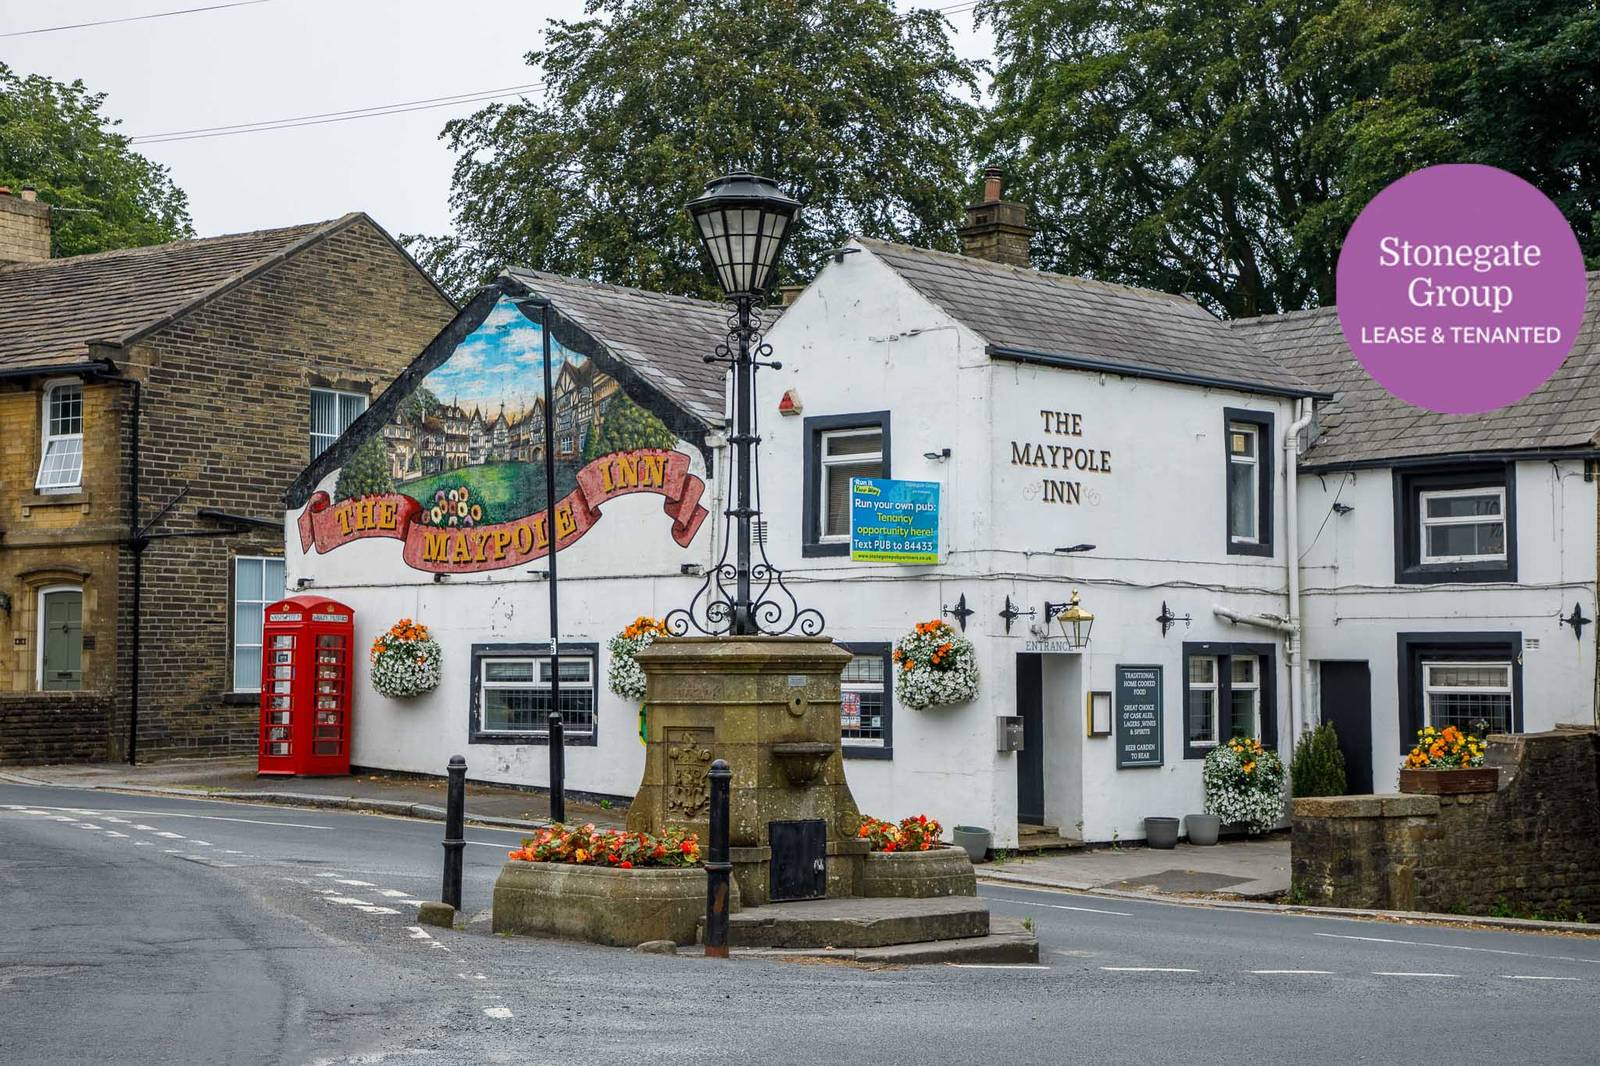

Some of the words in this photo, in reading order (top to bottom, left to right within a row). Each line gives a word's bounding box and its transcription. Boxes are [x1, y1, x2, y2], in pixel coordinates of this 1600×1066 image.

[1040, 410, 1082, 437] THE
[1011, 441, 1112, 474] MAYPOLE
[336, 501, 398, 537] THE
[599, 456, 669, 493] INN
[1042, 479, 1082, 505] INN
[855, 499, 872, 508] Run
[874, 502, 893, 511] your
[916, 503, 936, 513] pub:
[877, 512, 913, 525] Tenancy
[857, 526, 909, 538] opportunity
[910, 527, 934, 536] here!
[854, 540, 872, 549] Text
[874, 541, 891, 550] PUB
[893, 542, 902, 550] to
[904, 541, 933, 551] 84433
[1026, 640, 1073, 651] ENTRANCE
